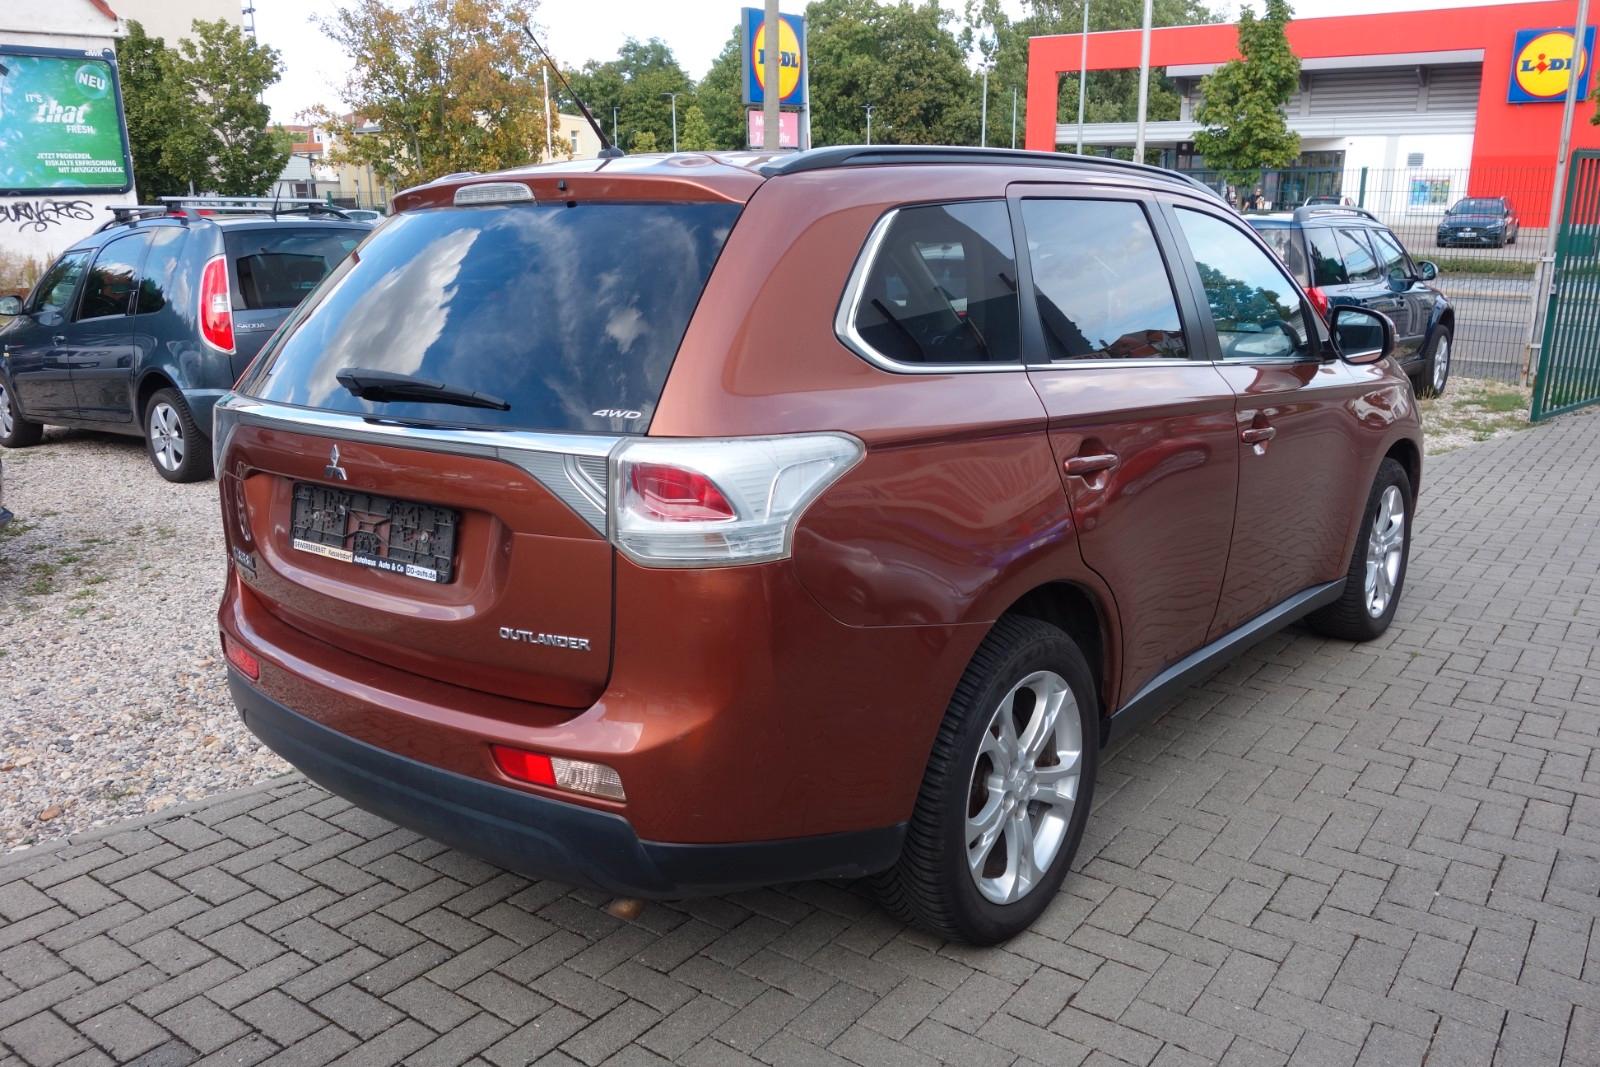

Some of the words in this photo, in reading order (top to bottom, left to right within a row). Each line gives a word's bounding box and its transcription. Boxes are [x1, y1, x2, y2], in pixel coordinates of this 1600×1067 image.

[78, 72, 106, 91] NEU
[36, 99, 91, 124] that
[36, 152, 55, 160] JETZT
[592, 409, 642, 419] 4WD
[354, 555, 376, 567] Autohaus
[378, 560, 391, 571] Auto
[397, 564, 404, 573] Co
[499, 626, 592, 652] OUTLANDER
